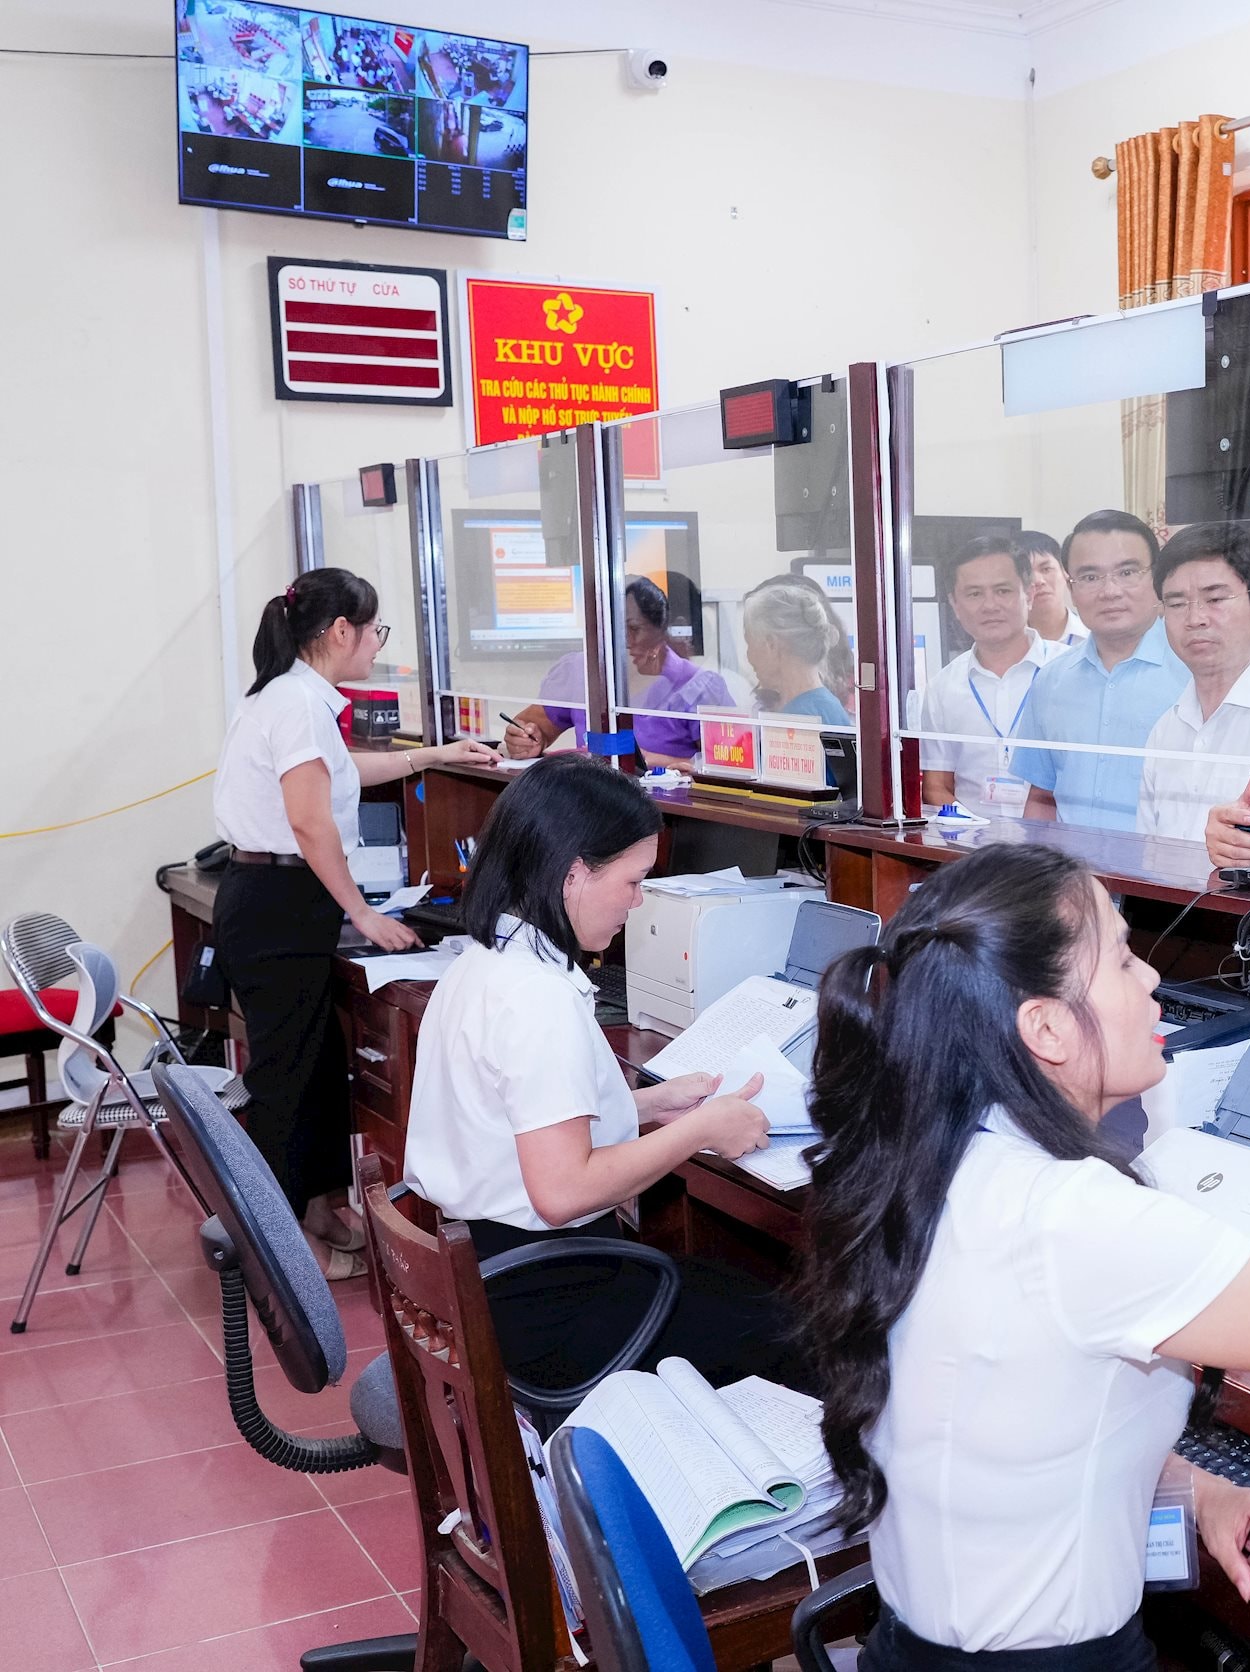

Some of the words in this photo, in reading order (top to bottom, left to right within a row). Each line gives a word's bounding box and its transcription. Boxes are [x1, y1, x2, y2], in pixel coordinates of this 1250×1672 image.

[494, 338, 564, 366] KHU
[573, 341, 634, 374] VỰC
[480, 379, 500, 397] TRA
[502, 376, 523, 398] CỨU
[526, 378, 547, 399] CÁC
[549, 376, 569, 401] THỦ
[570, 383, 589, 404] TỤC
[592, 382, 619, 402] HÀNH
[621, 384, 651, 404] CHÍNH
[502, 404, 516, 425] VÀ
[518, 405, 539, 425] NỘP
[713, 741, 729, 761] GIÁO
